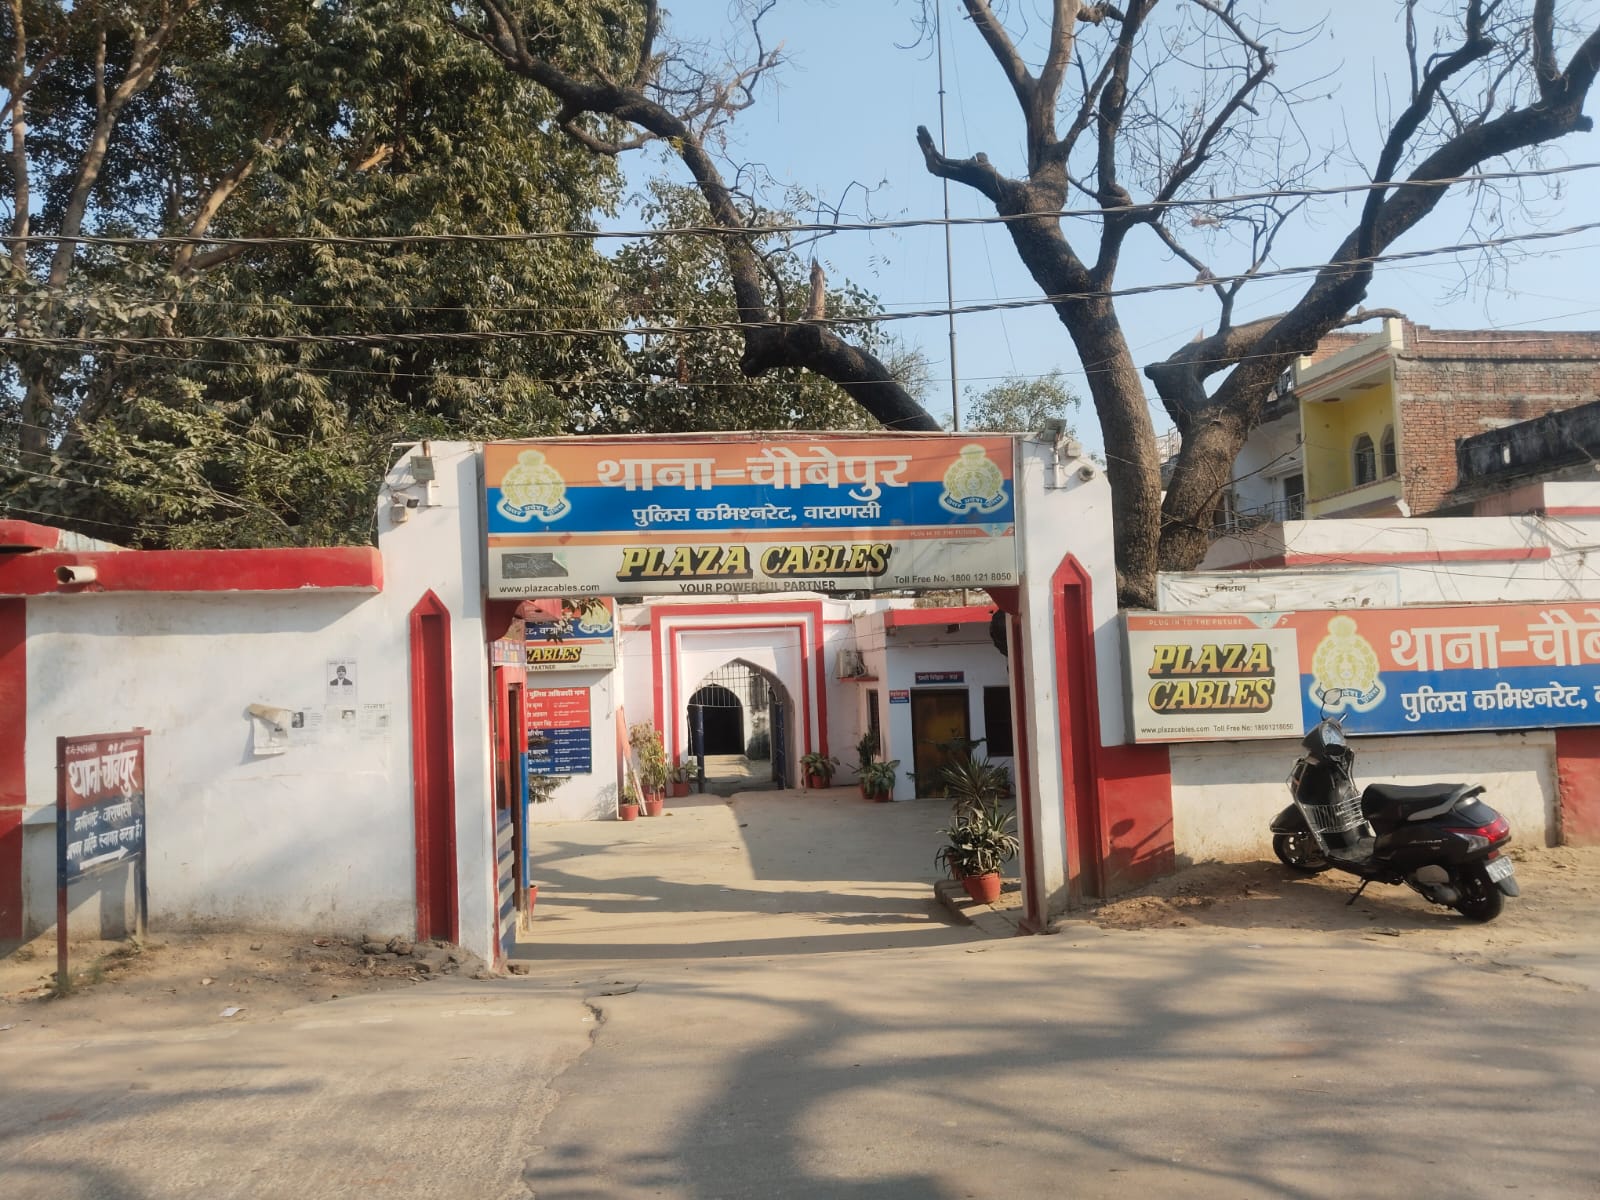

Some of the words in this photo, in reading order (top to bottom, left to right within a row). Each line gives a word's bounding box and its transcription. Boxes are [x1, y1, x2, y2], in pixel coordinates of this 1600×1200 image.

[632, 504, 690, 527] पुलिस
[695, 503, 797, 521] कमिश्नरेट,
[804, 501, 881, 519] वाराणसी
[617, 546, 752, 582] PLAZA
[761, 544, 892, 578] CABLES
[679, 583, 712, 593] YOUR
[784, 581, 836, 592] PARTNER
[894, 575, 909, 584] Toll
[912, 575, 931, 584] Free
[934, 575, 948, 583] No.
[951, 573, 970, 582] 1800
[974, 573, 988, 582] 121
[991, 572, 1011, 581] 8050
[499, 583, 600, 594] www.plazacables.com
[1149, 618, 1168, 626] PLUG
[1149, 643, 1275, 679] PLAZA
[1148, 679, 1275, 715] CABLES
[1401, 685, 1467, 722] पुलिस
[1472, 681, 1587, 711] कमिश्नरेट,
[1227, 724, 1240, 732] Free
